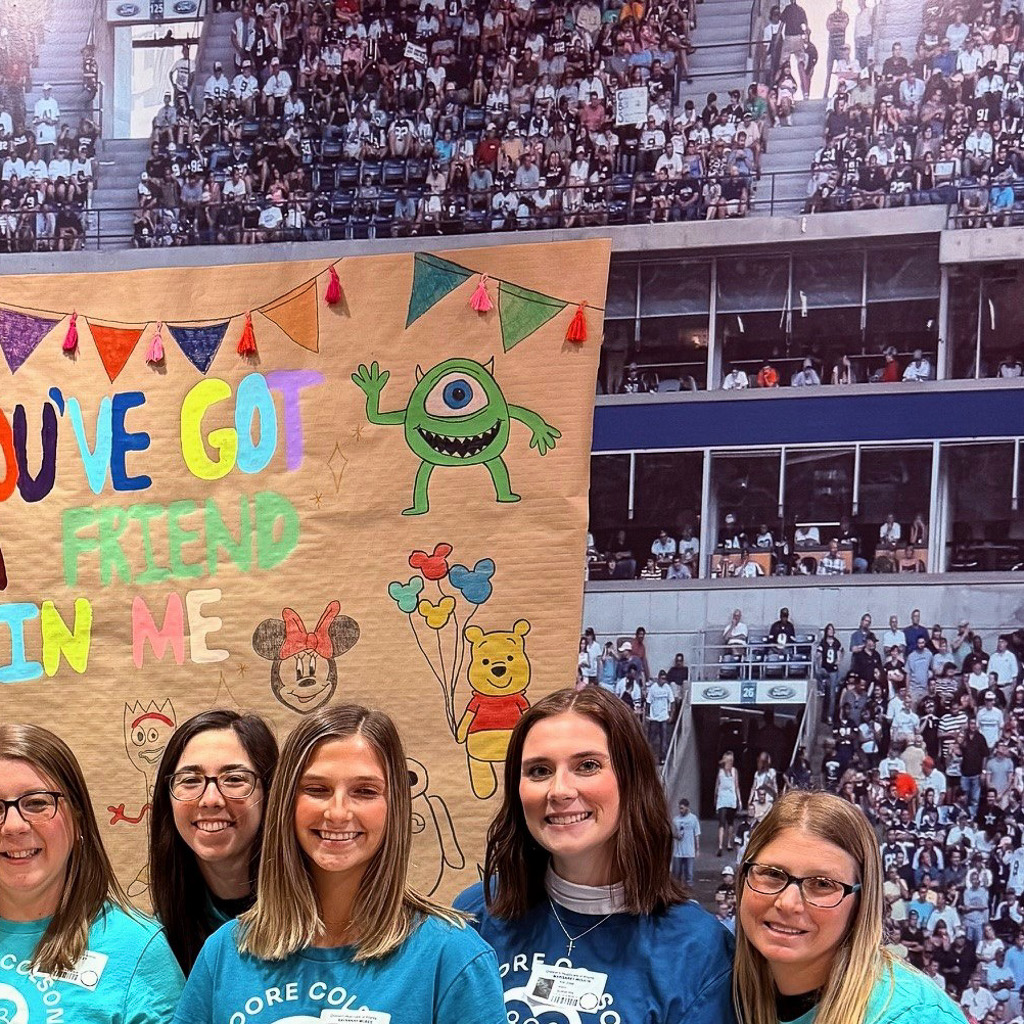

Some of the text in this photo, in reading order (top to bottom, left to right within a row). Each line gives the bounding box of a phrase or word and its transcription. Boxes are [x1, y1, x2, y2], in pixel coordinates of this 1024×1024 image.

[149, 3, 164, 14] 125
[976, 108, 989, 121] 91
[27, 197, 36, 208] 9
[179, 369, 325, 480] GOT
[61, 490, 302, 588] FRIEND
[131, 588, 230, 669] ME
[827, 649, 834, 664] 9
[743, 687, 754, 698] 26
